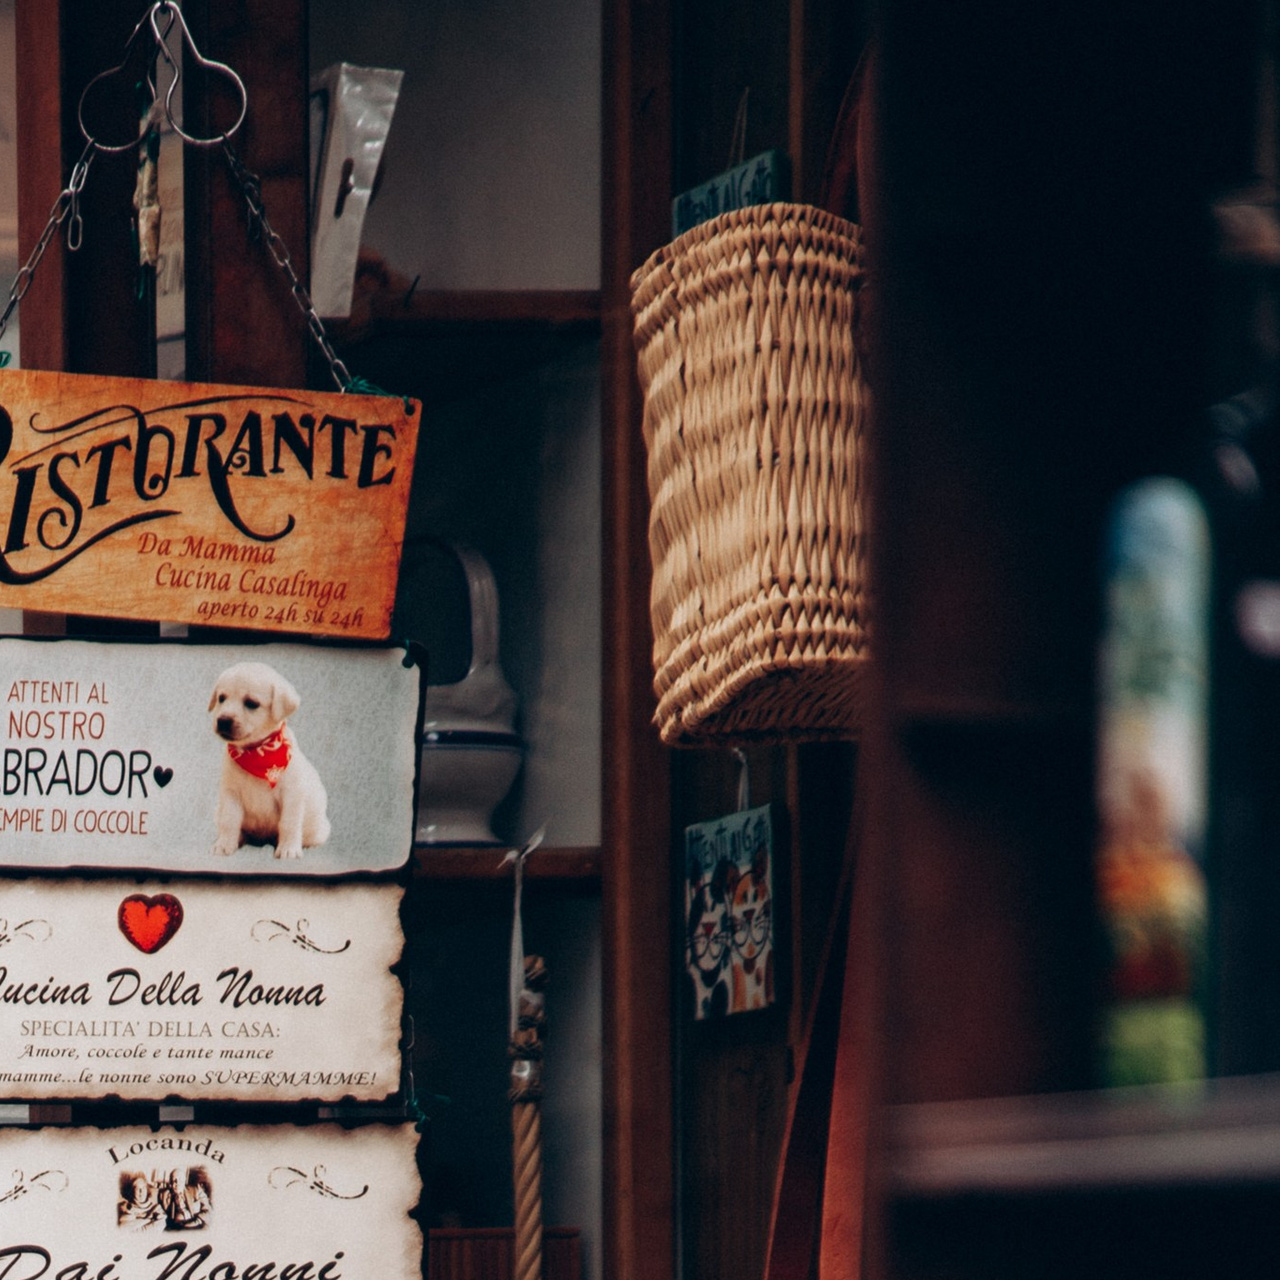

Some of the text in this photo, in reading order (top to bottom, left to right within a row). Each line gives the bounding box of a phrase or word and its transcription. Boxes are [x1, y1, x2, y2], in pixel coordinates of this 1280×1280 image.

[138, 531, 276, 565] Da Mamma
[155, 563, 349, 602] Cucina Casalinga
[198, 600, 364, 628] aperto 24h 24h
[8, 680, 109, 705] ATTENTI AL
[8, 710, 106, 741] NOSTRO
[51, 809, 68, 834] DI
[74, 810, 148, 836] COCCOLE
[106, 968, 204, 1008] Della
[216, 966, 327, 1009] Nonna
[20, 1019, 280, 1038] SPECIALITA' DELLA CASA:
[18, 1043, 274, 1061] Amore, coccole tante mance
[99, 1071, 151, 1084] nonne
[157, 1072, 198, 1084] sono
[200, 1070, 377, 1087] SUPERMAMME!
[106, 1134, 228, 1166] Locanda
